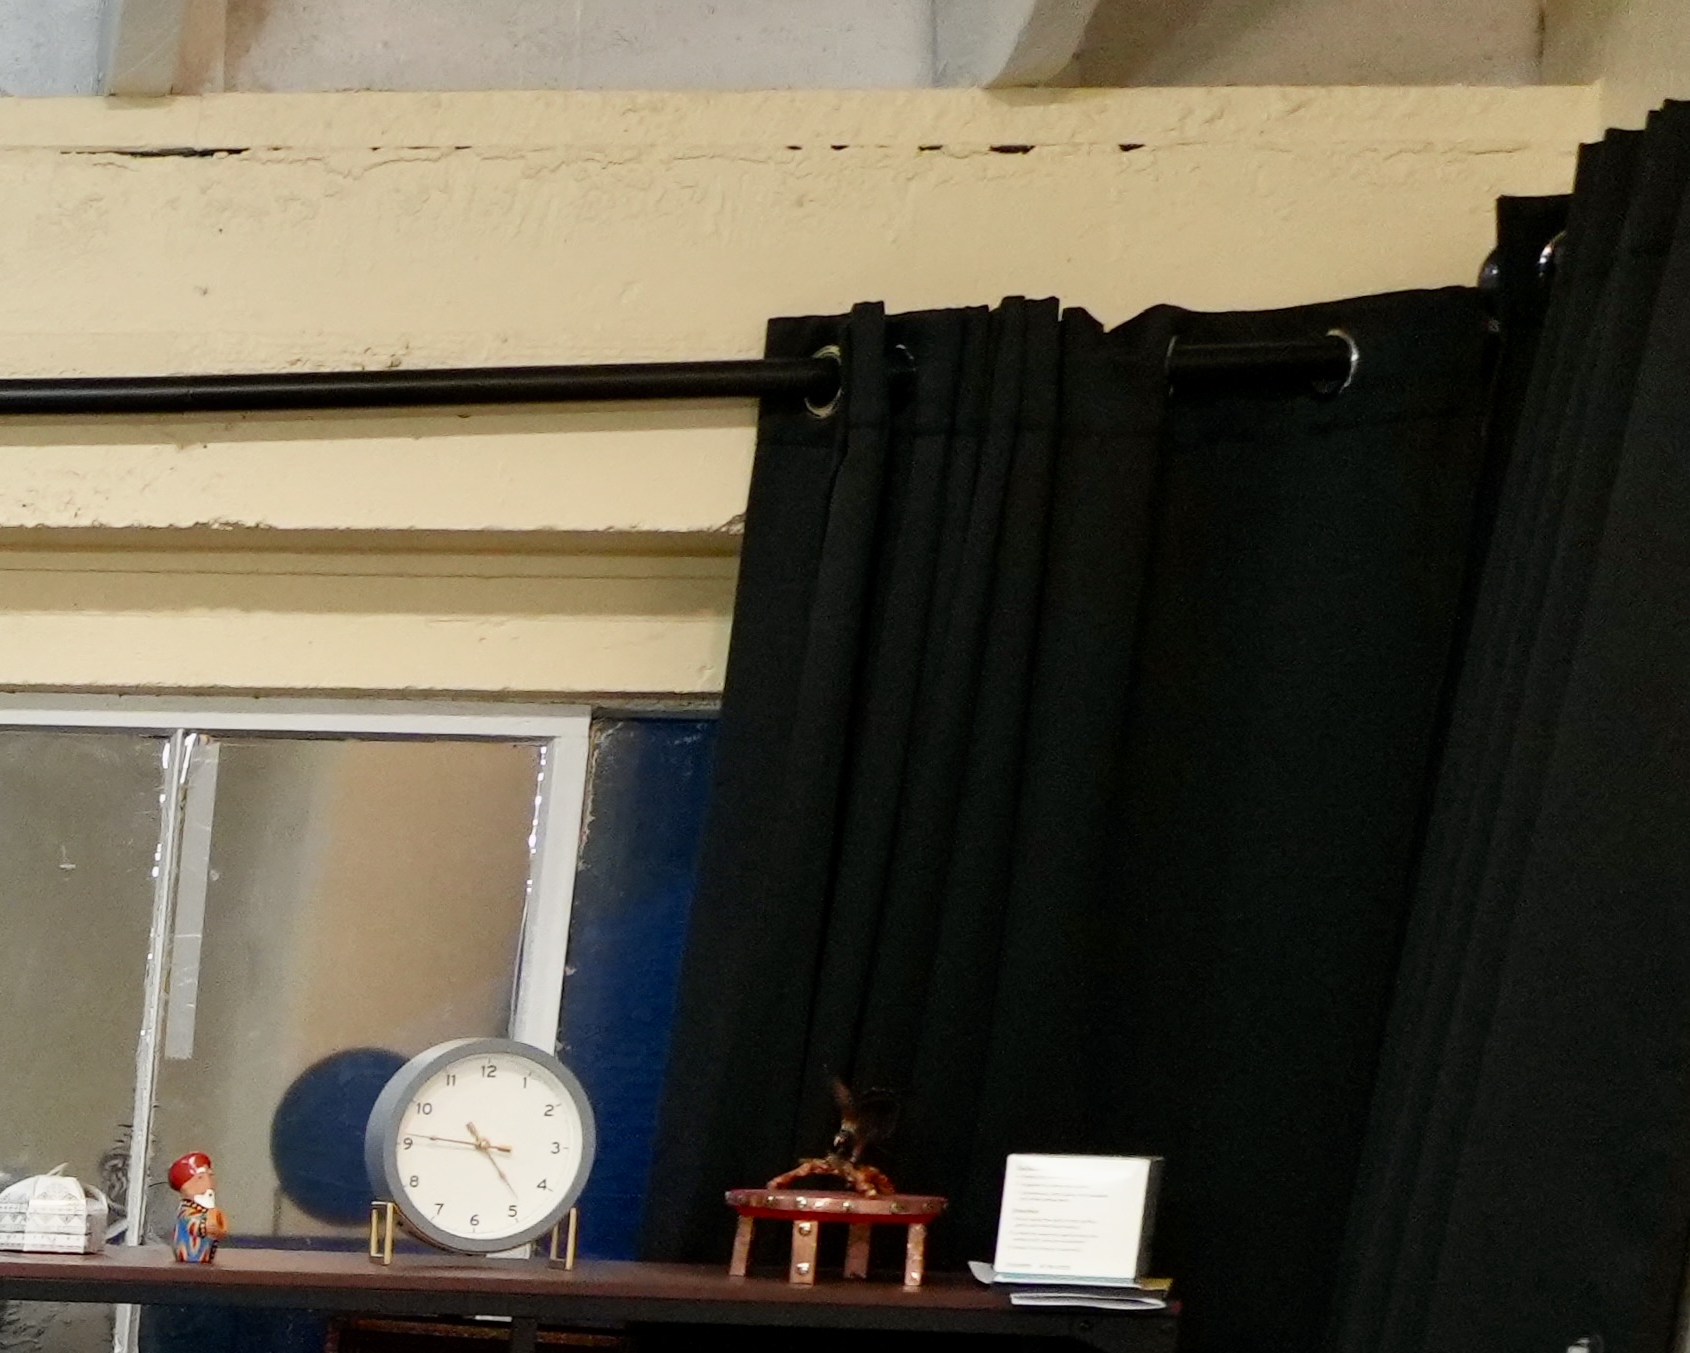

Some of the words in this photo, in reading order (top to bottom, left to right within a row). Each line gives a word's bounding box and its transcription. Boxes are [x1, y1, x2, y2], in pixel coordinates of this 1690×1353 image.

[481, 1065, 497, 1078] 12
[446, 1074, 457, 1086] 11
[522, 1076, 528, 1089] 1
[417, 1102, 433, 1115] 10
[544, 1104, 554, 1117] 2
[403, 1138, 413, 1150] 9
[551, 1142, 560, 1154] 3
[409, 1176, 419, 1187] 8
[536, 1179, 547, 1190] 4
[435, 1204, 444, 1215] 7
[508, 1205, 517, 1218] 5
[470, 1214, 479, 1226] 6
